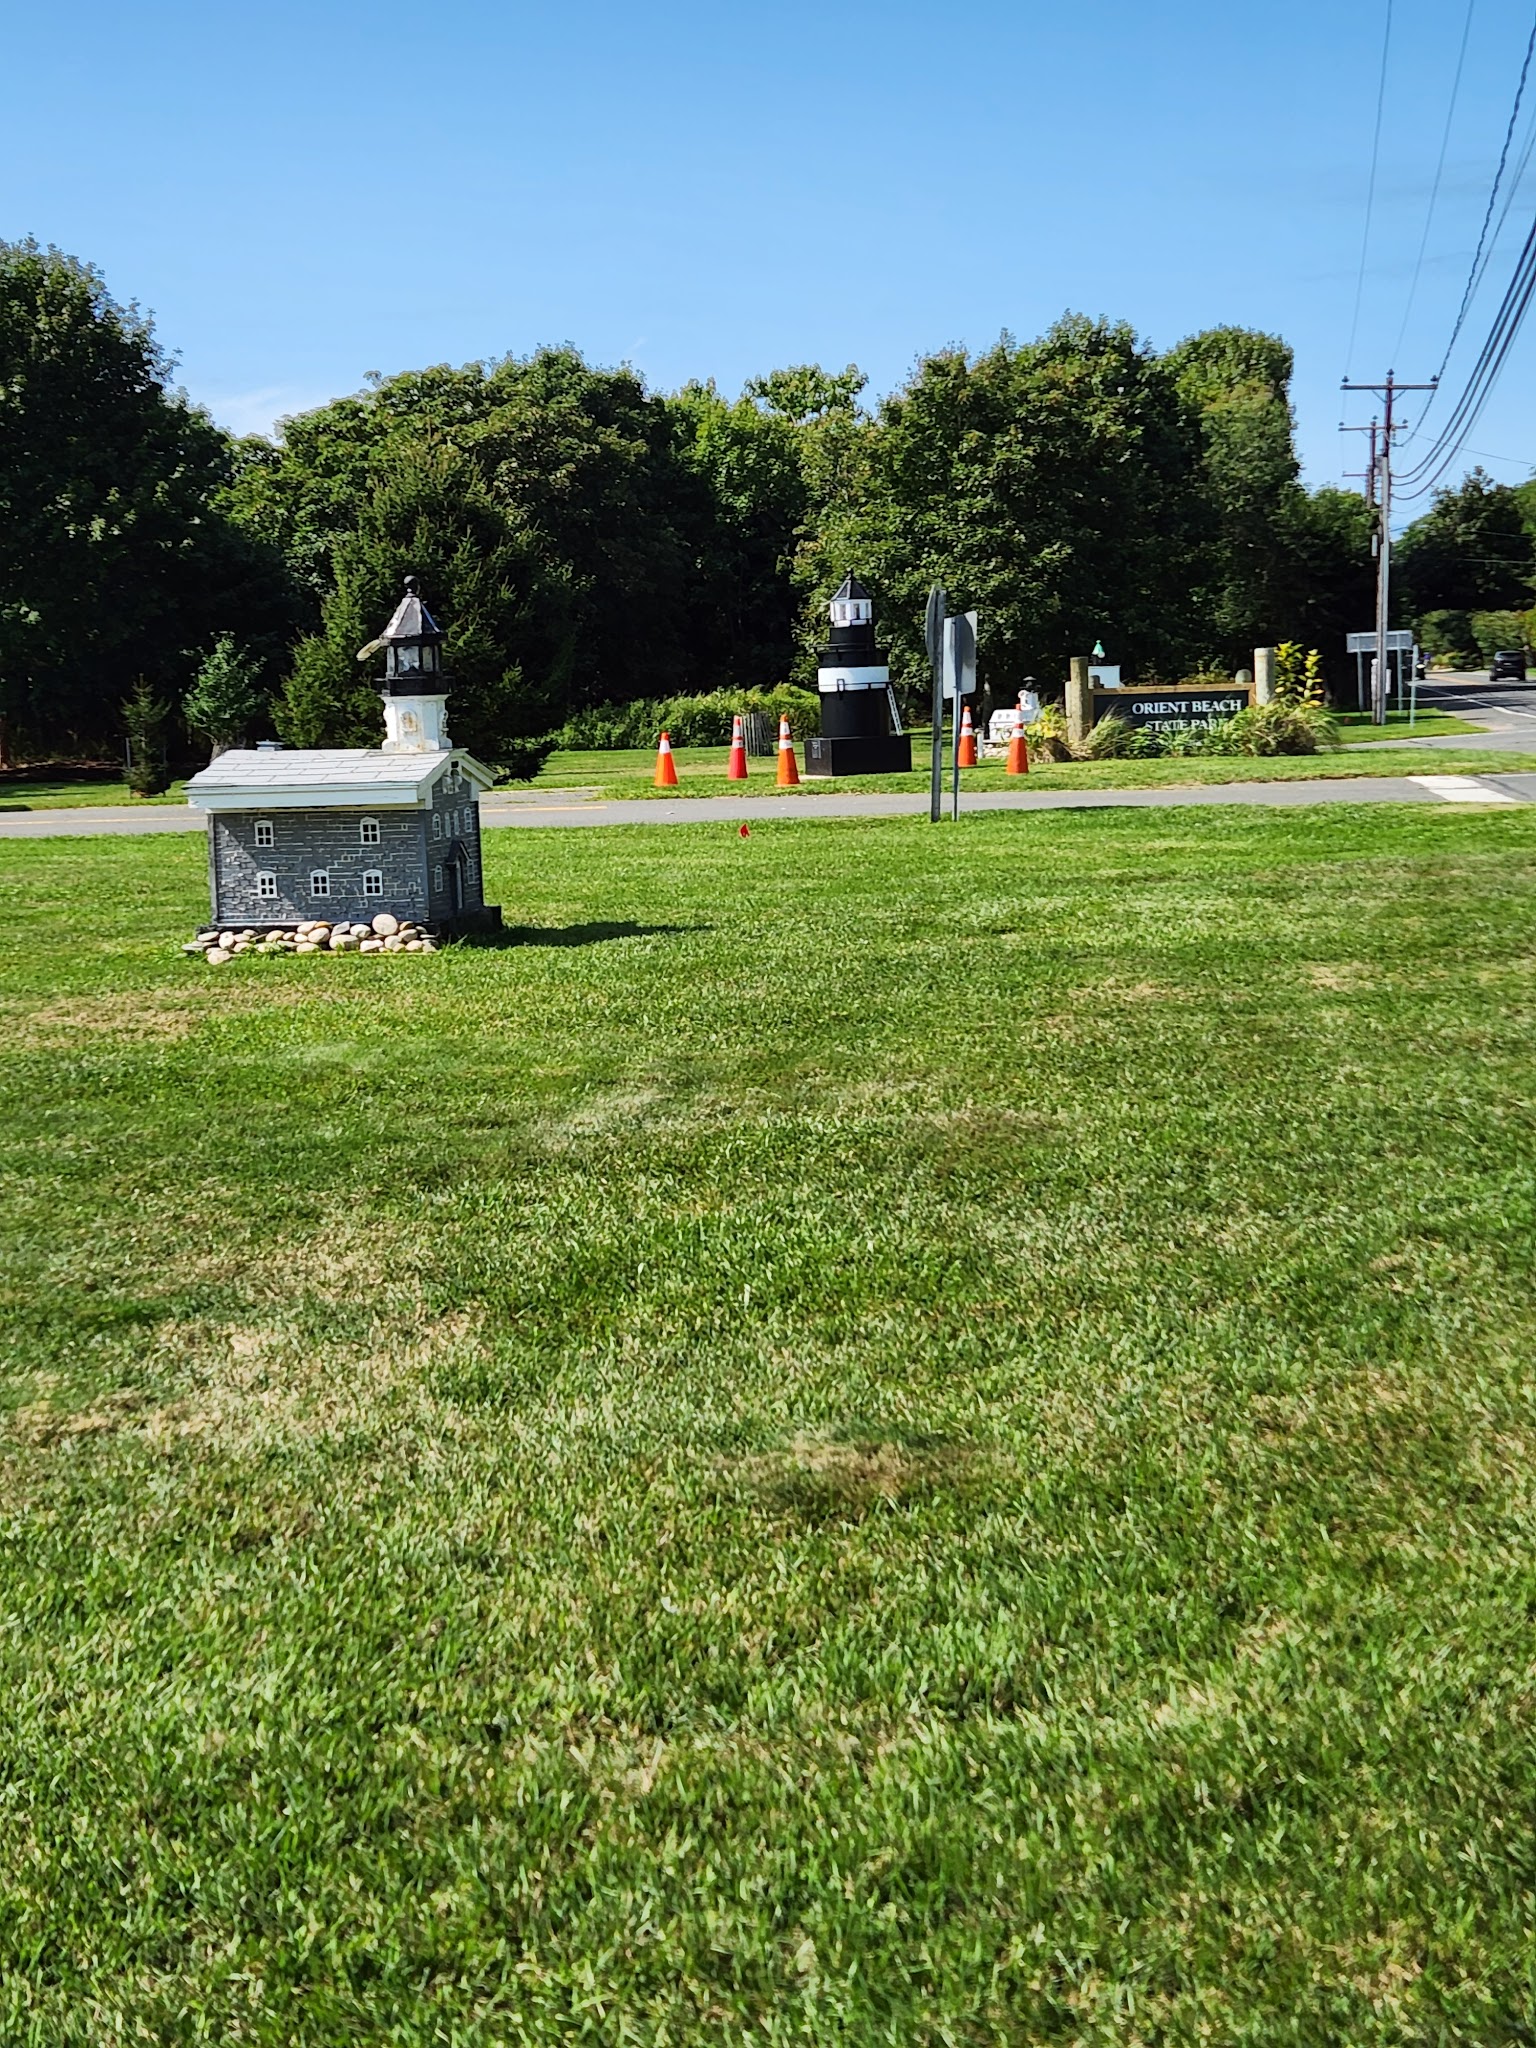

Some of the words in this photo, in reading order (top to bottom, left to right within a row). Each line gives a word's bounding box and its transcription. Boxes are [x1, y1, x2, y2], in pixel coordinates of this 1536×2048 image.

[1132, 701, 1190, 714] ORIENT
[1191, 699, 1242, 713] BEACH
[1145, 719, 1188, 731] STATE
